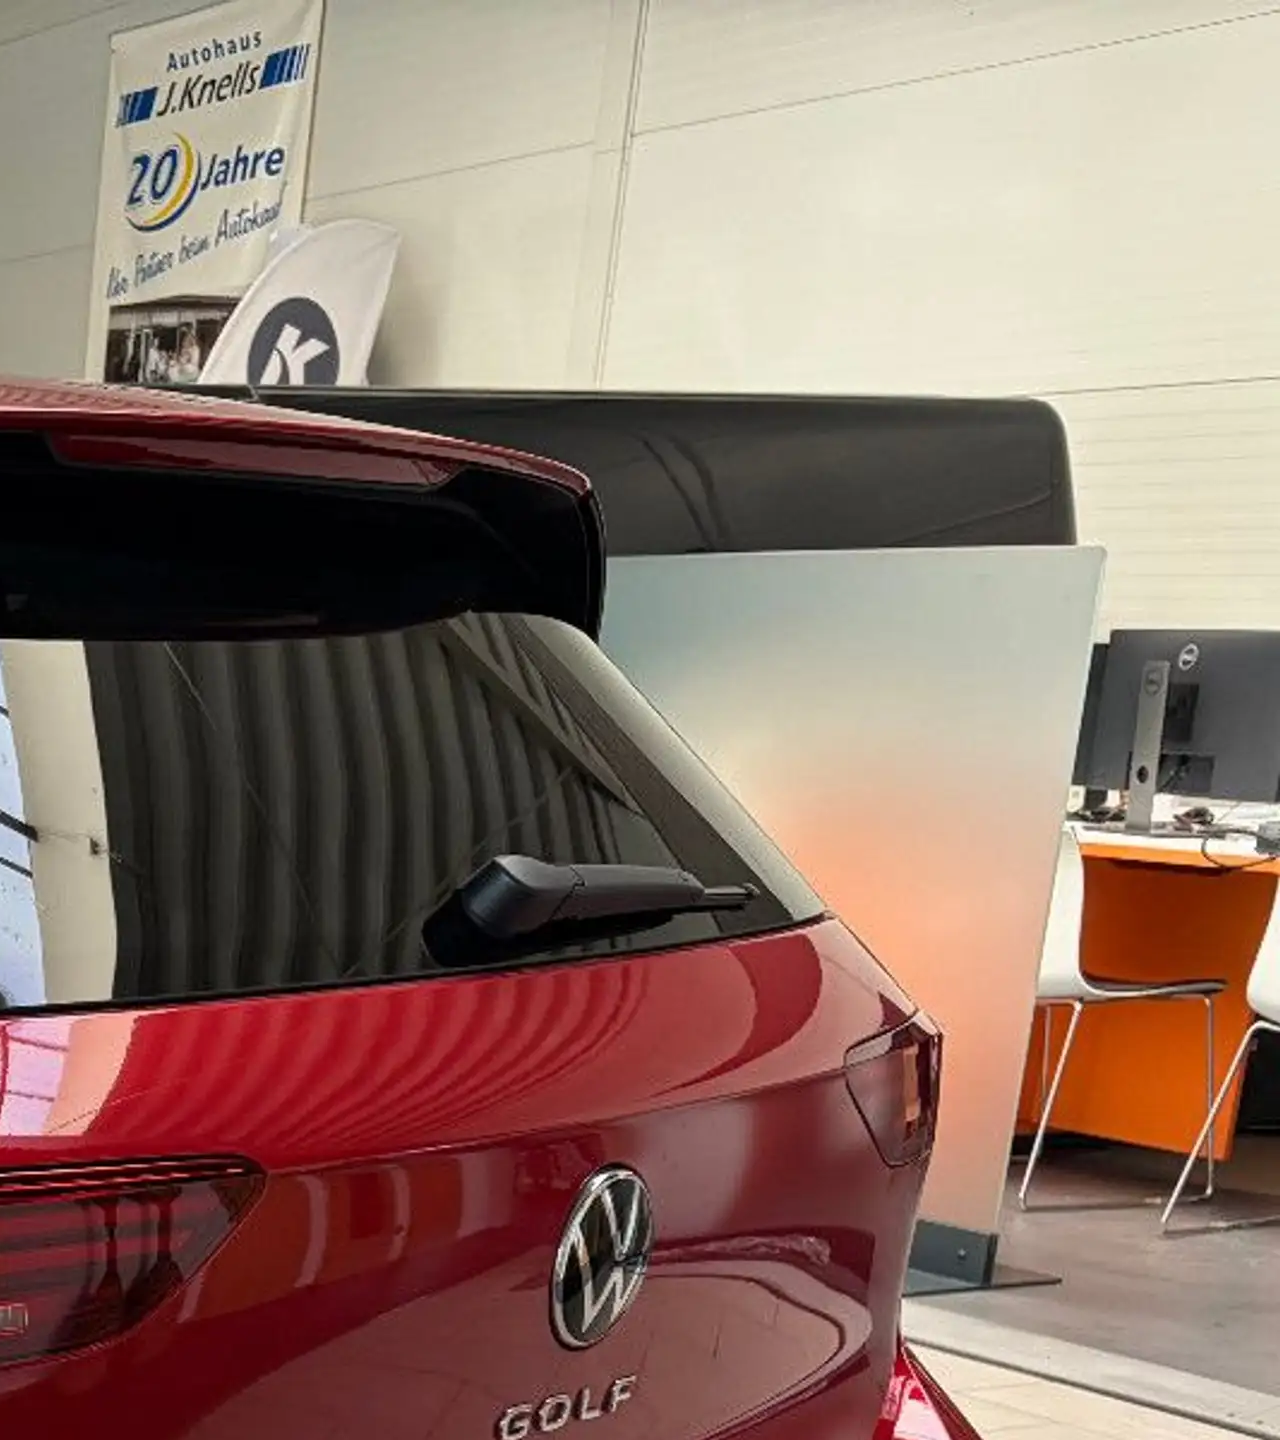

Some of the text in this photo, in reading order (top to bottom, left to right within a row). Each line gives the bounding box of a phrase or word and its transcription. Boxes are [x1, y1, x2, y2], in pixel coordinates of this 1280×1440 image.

[166, 31, 262, 72] Autohaus
[156, 60, 262, 117] J.Knells
[127, 145, 285, 206] 20 Jahre
[497, 1375, 637, 1440] GOLF
